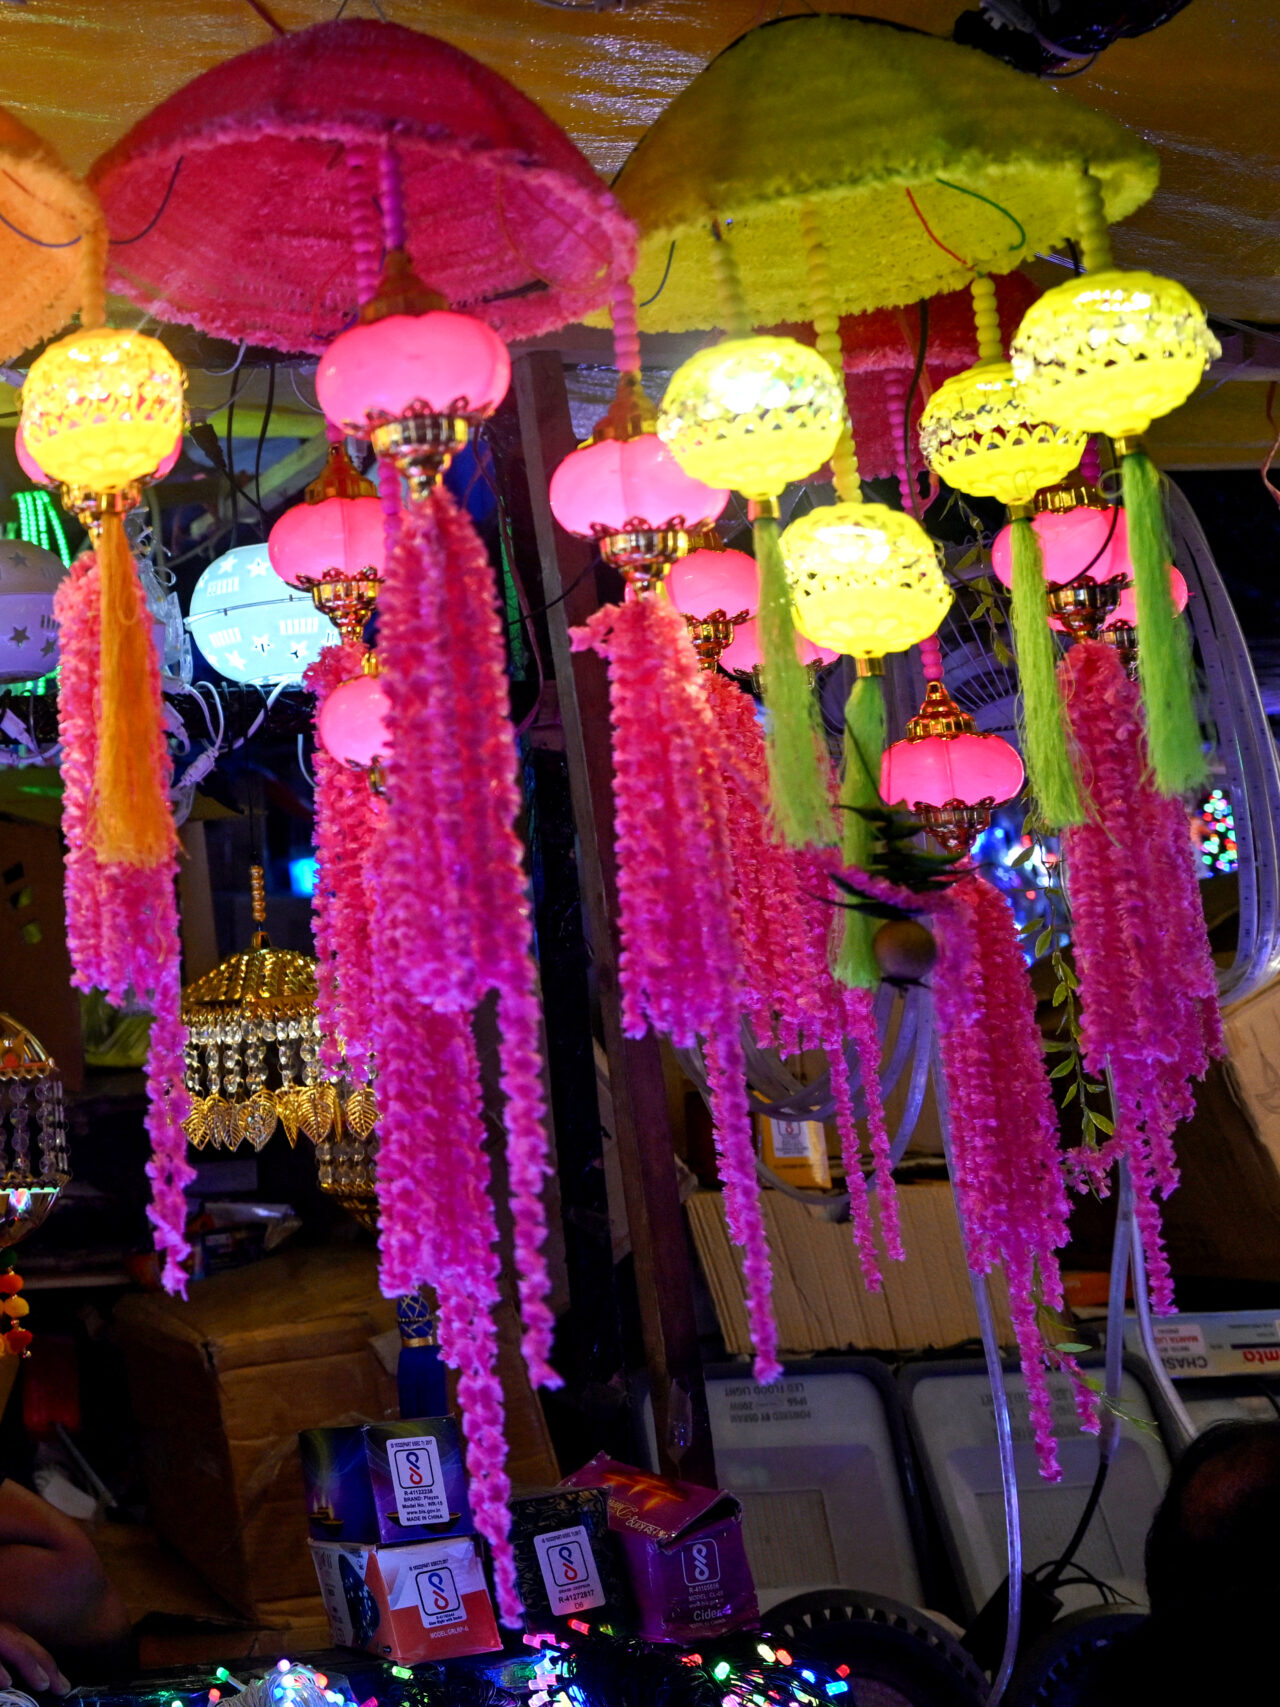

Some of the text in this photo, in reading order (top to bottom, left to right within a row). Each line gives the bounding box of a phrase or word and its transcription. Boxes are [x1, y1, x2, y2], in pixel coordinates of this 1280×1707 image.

[725, 1386, 751, 1397] LIGHT
[761, 1412, 771, 1422] BY
[773, 1411, 812, 1421] POWERED
